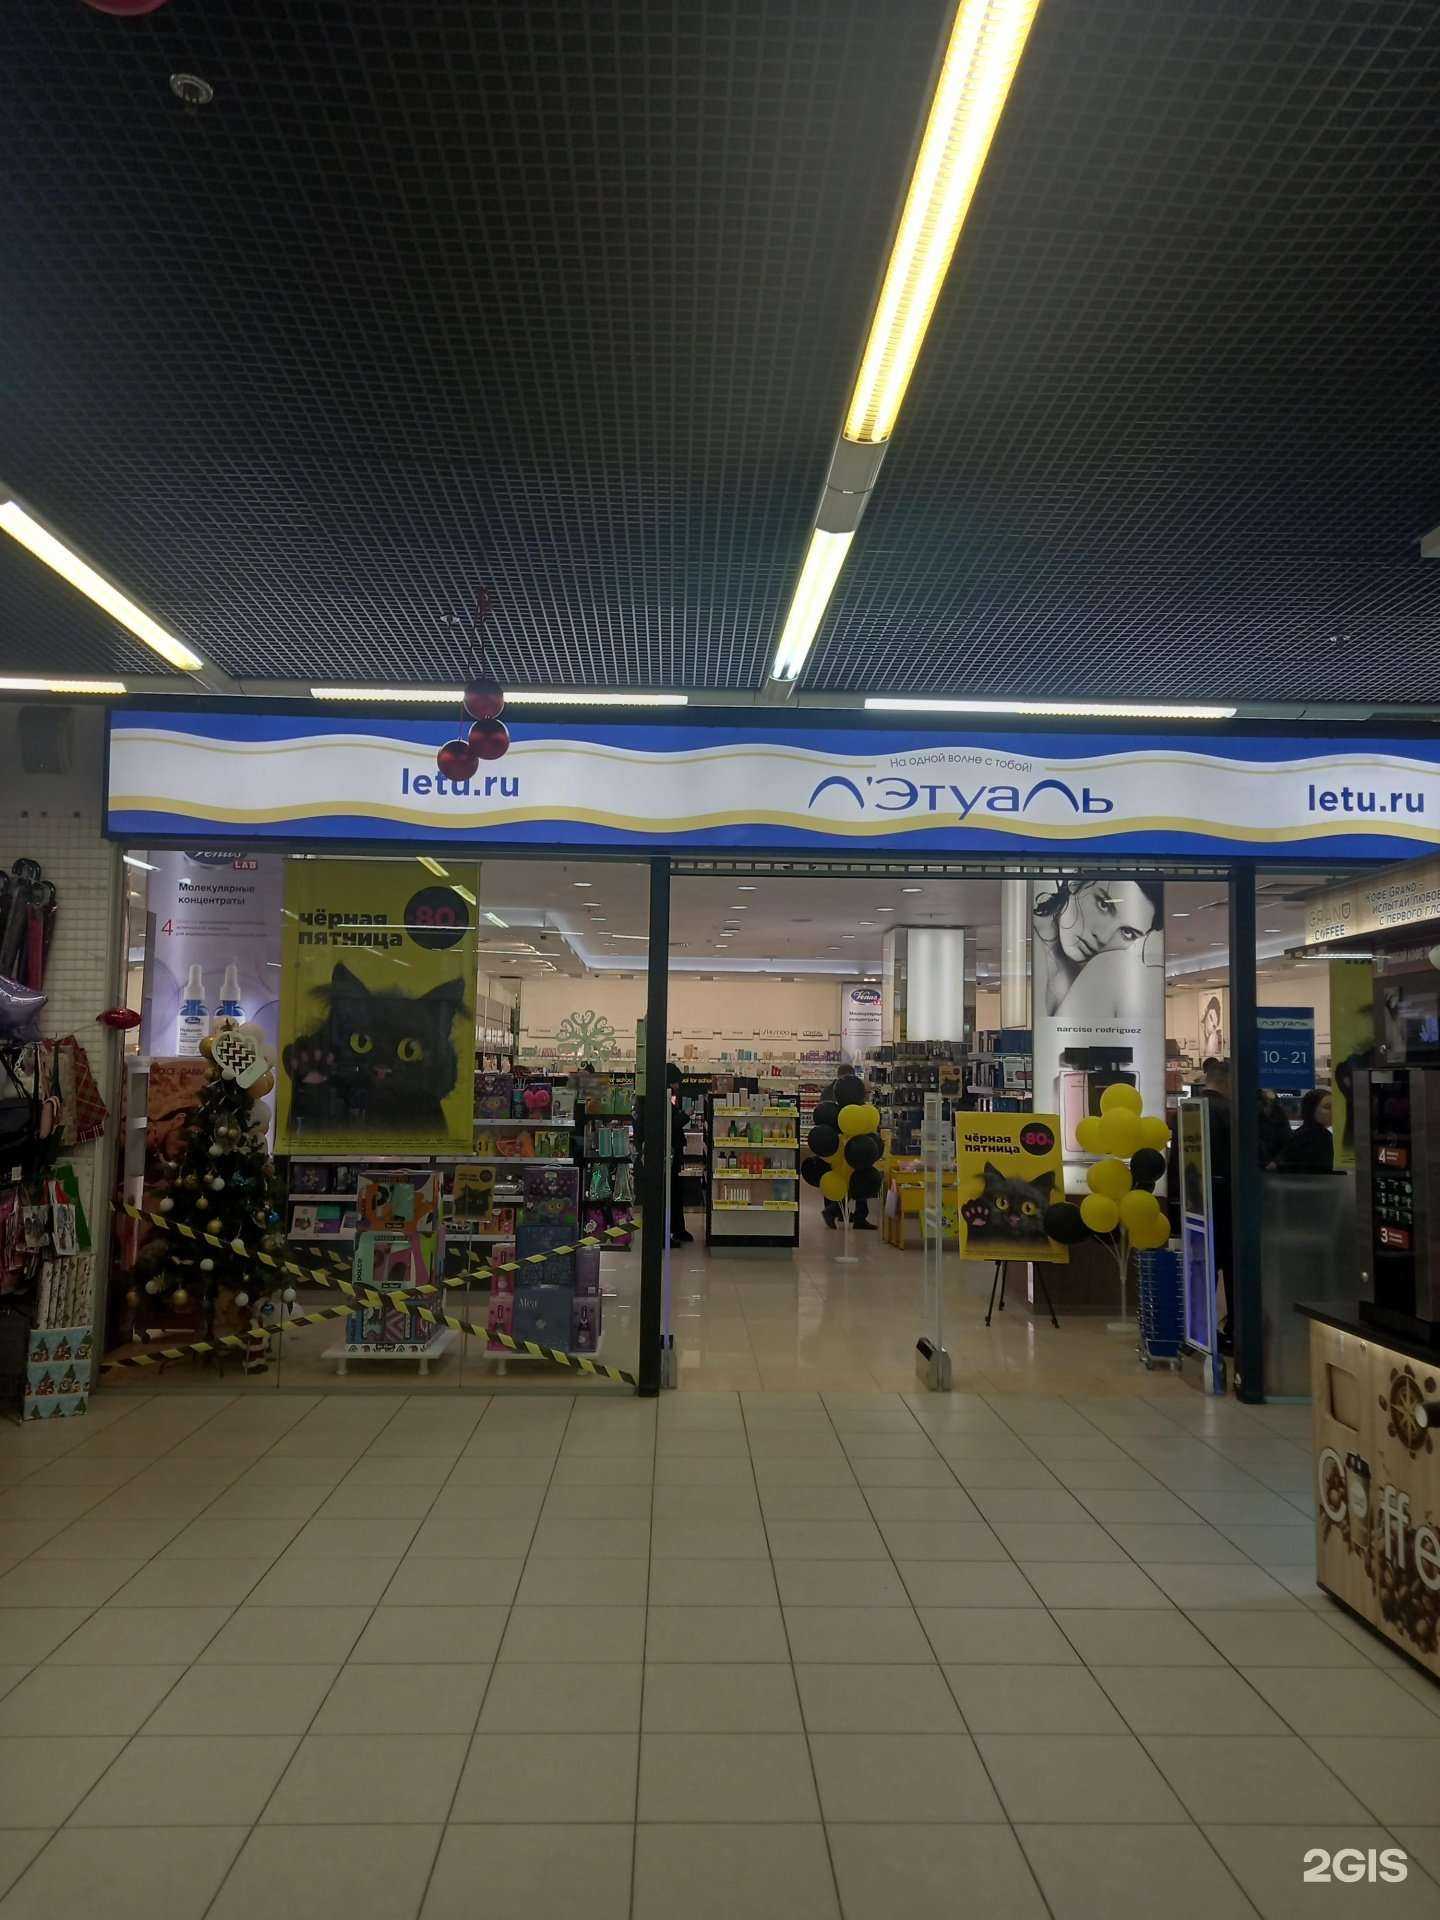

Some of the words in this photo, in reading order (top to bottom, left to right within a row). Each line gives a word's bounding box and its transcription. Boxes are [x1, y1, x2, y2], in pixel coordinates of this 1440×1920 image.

[890, 759, 906, 768] На
[909, 753, 945, 766] одной
[948, 754, 982, 764] волне
[995, 760, 1032, 773] тобой!
[402, 768, 519, 797] letu.ru
[1308, 784, 1425, 813] letu.ru
[233, 860, 257, 869] LAB
[178, 882, 255, 894] Молекулярные
[178, 896, 245, 905] концентраты
[299, 908, 388, 930] чёрная
[161, 919, 174, 936] 4
[299, 932, 403, 949] пятница
[1095, 1025, 1142, 1035] rodriguez
[964, 1133, 1012, 1144] чёрная
[964, 1144, 1020, 1155] пятница
